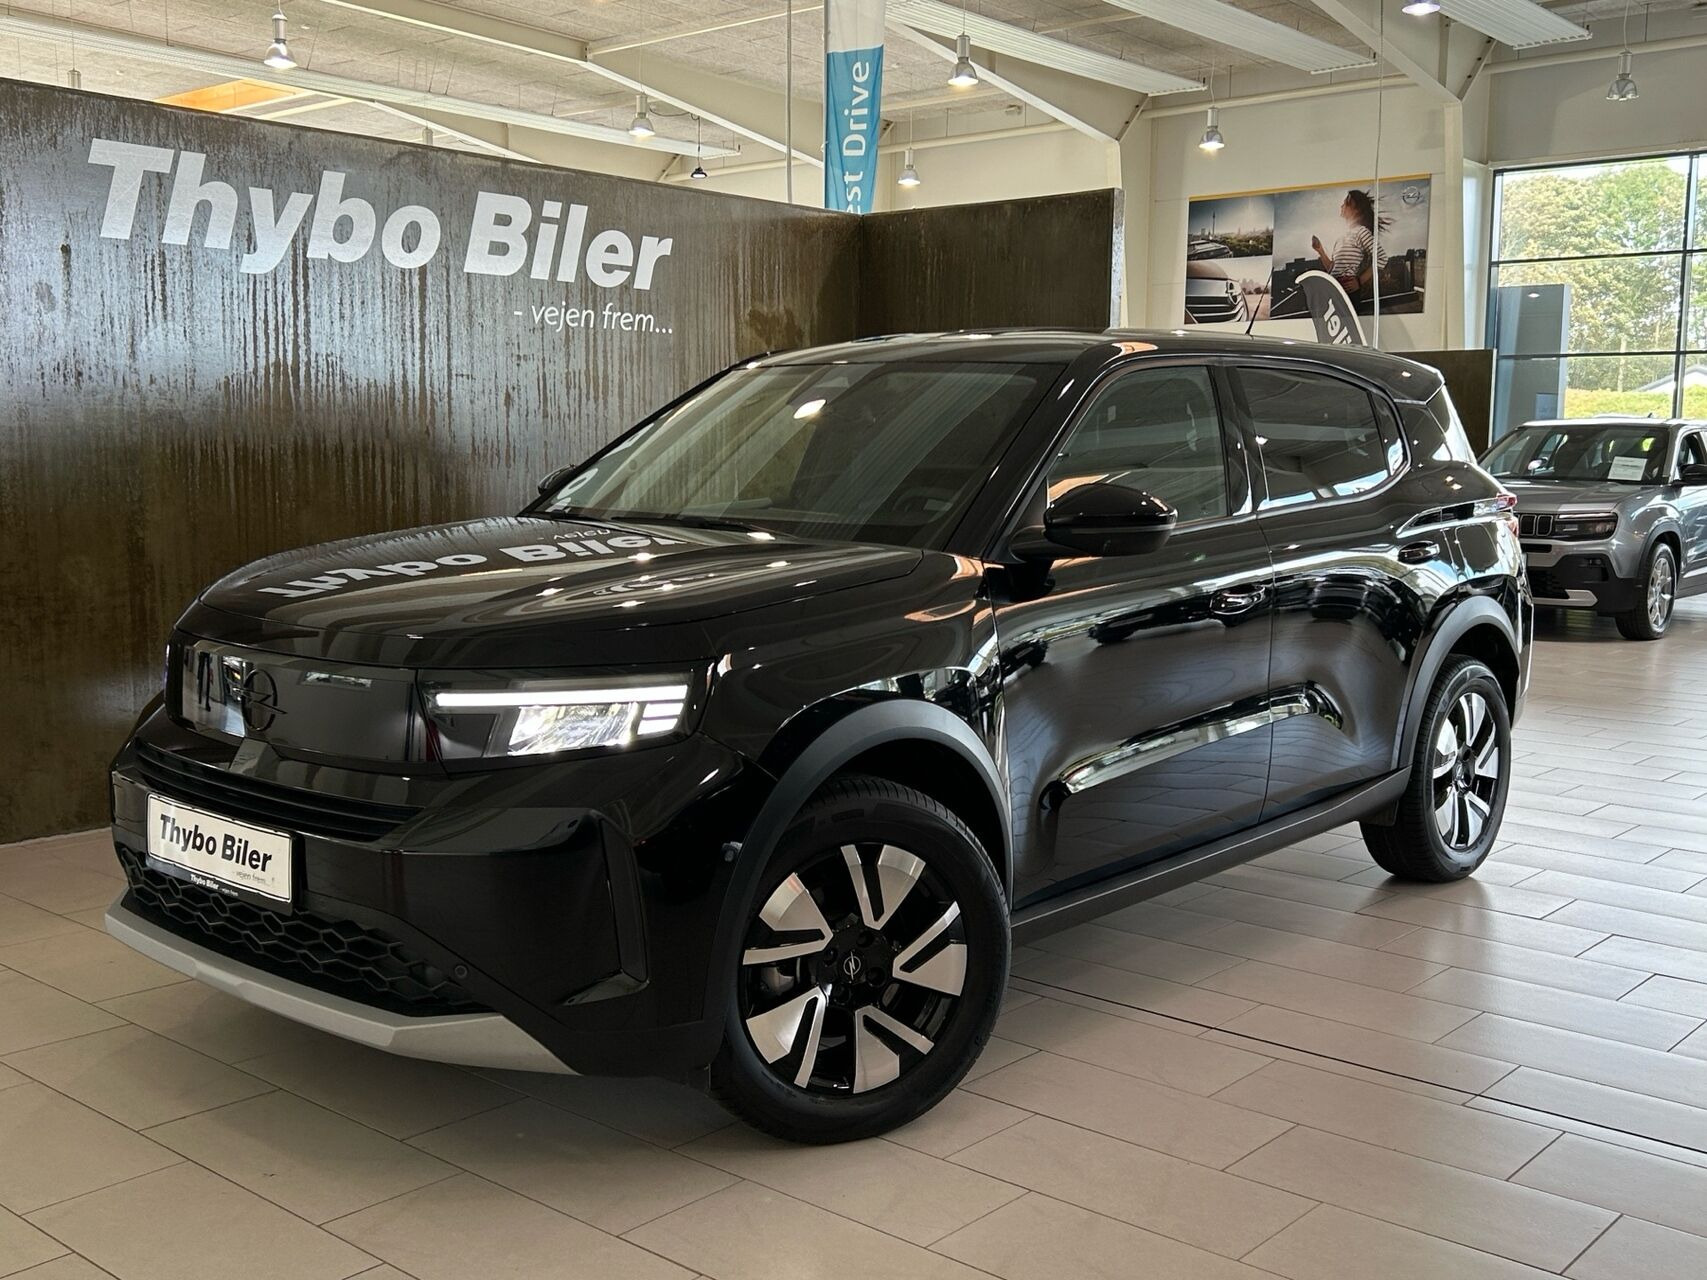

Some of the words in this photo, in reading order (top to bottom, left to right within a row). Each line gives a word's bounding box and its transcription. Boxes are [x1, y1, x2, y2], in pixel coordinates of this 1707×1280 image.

[842, 61, 869, 156] Drive
[87, 138, 441, 275] Thybo
[463, 191, 673, 291] Biler
[531, 300, 595, 333] vejen
[602, 302, 673, 334] frem...
[160, 813, 217, 855] Thybo
[221, 833, 272, 872] Biler
